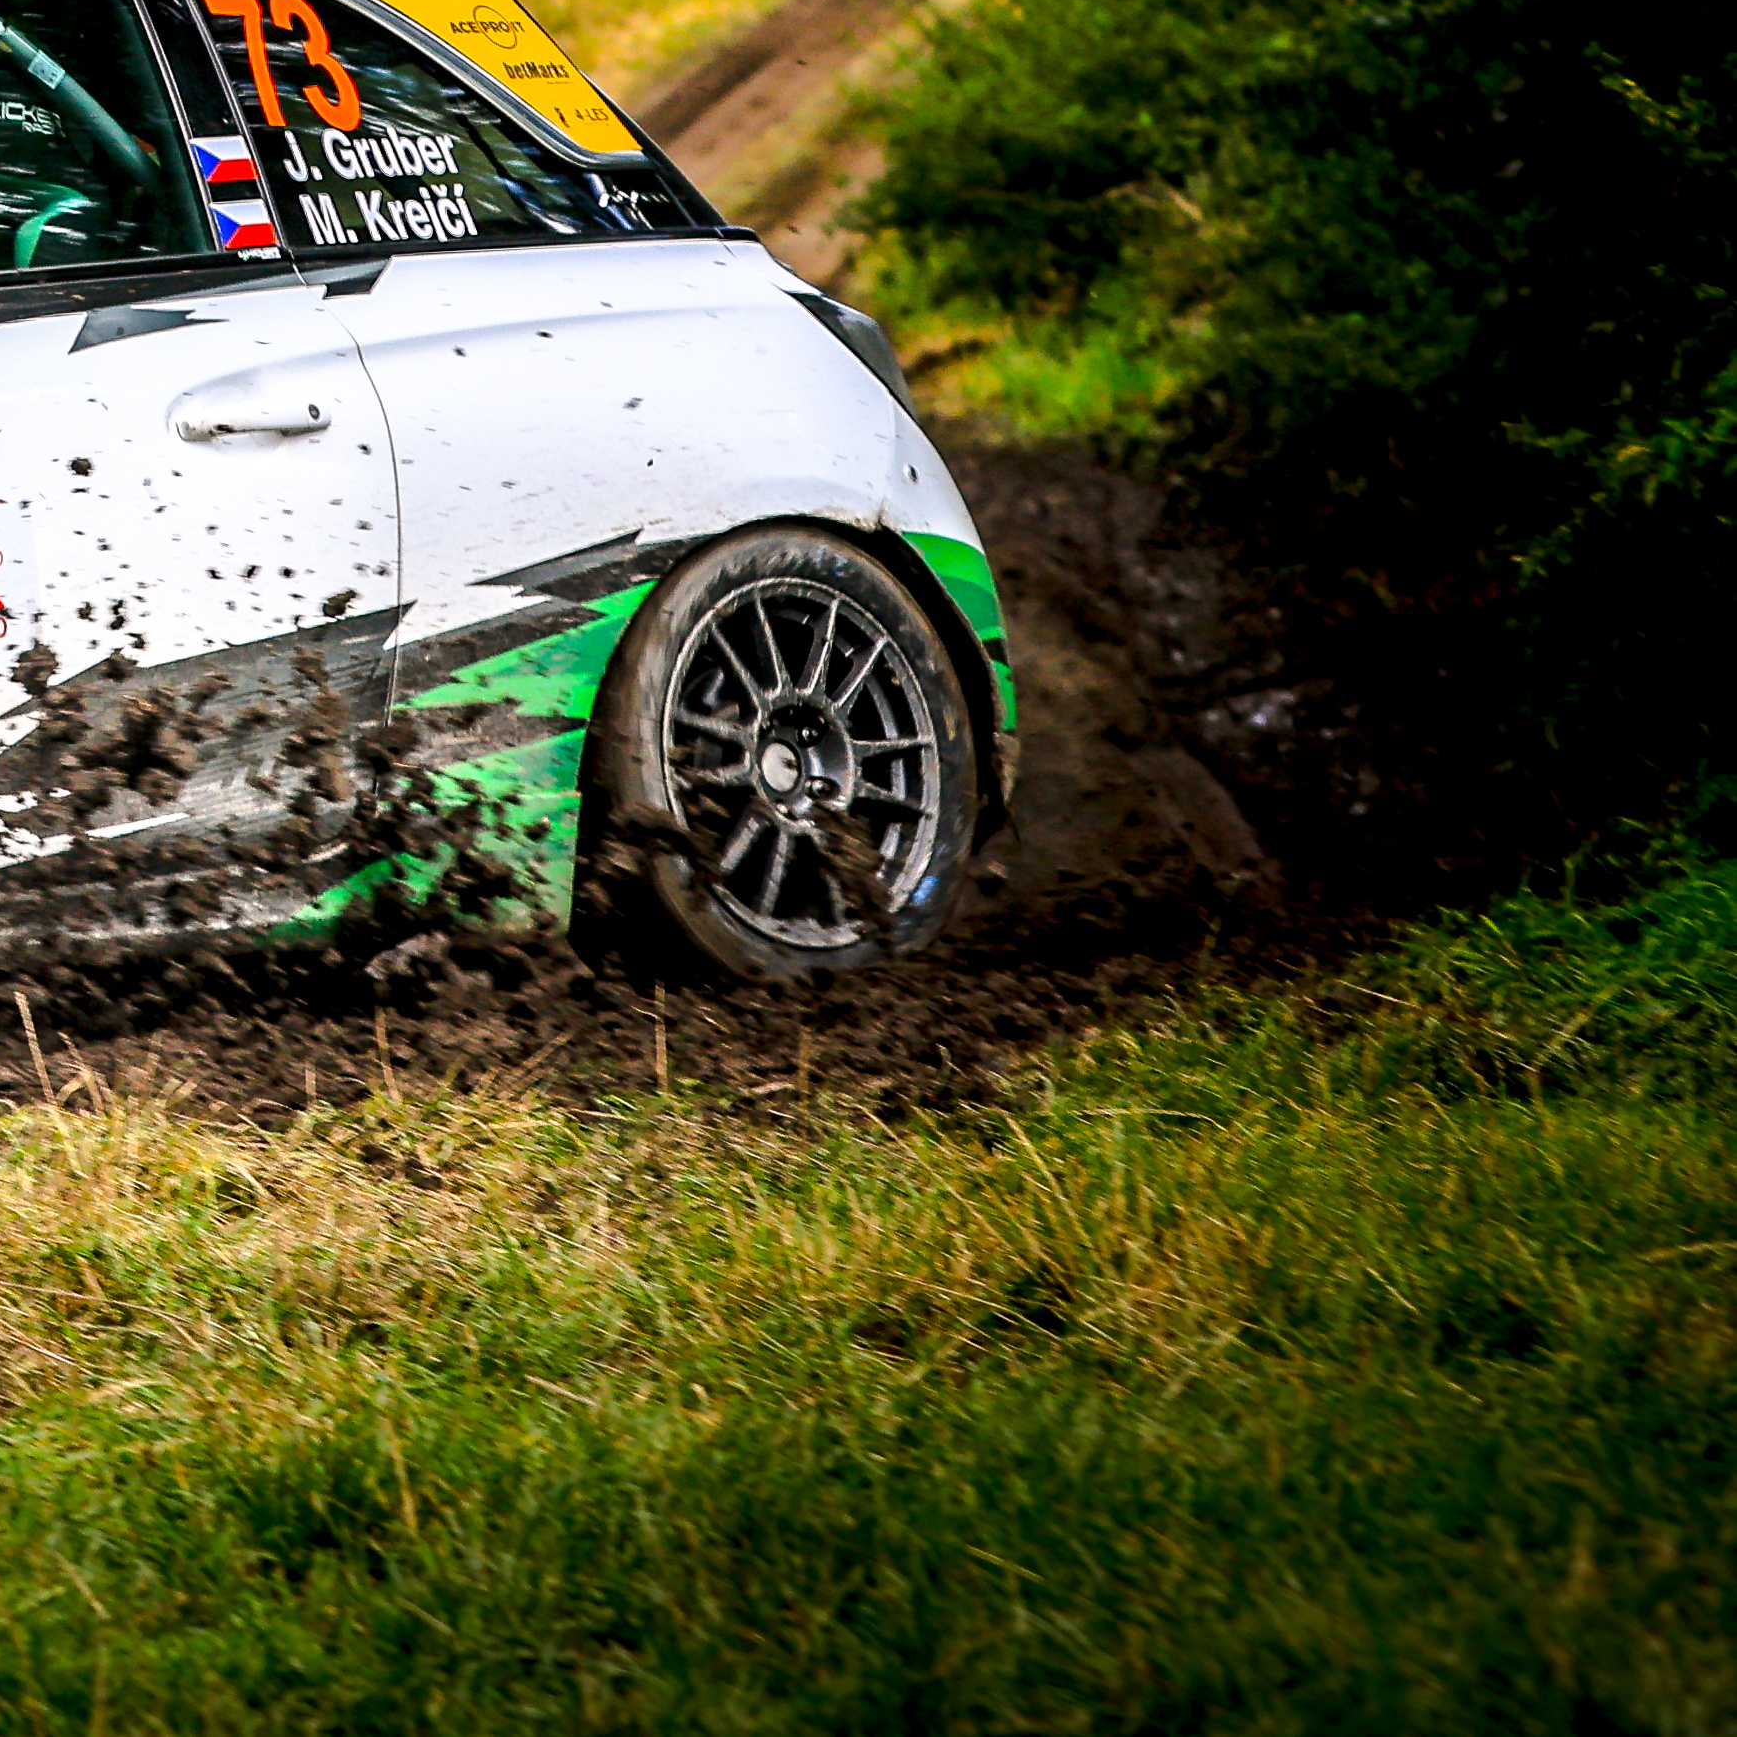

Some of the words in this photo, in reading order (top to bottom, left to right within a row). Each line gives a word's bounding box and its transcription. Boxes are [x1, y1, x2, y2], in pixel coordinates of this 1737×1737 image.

[449, 20, 480, 34] ACE
[282, 129, 323, 182] J.
[321, 126, 459, 181] Gruber
[298, 193, 359, 245] M.
[355, 183, 478, 242] Krejčí
